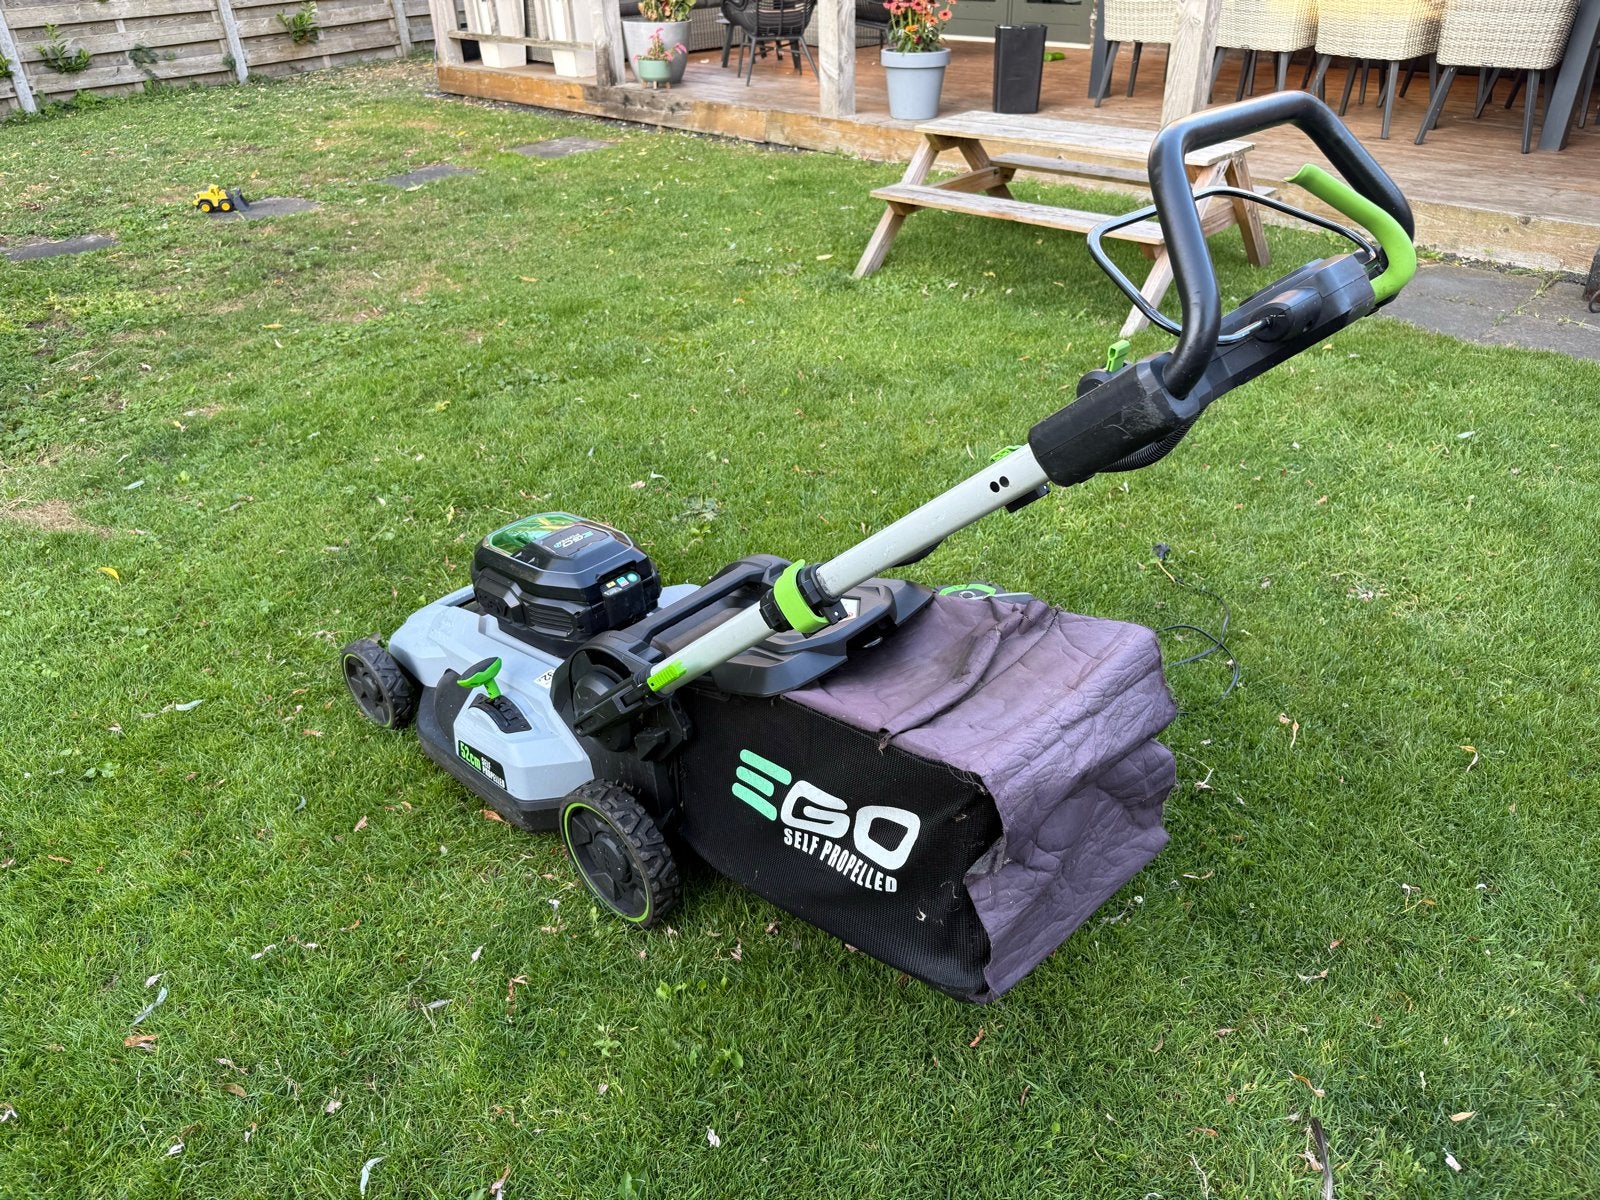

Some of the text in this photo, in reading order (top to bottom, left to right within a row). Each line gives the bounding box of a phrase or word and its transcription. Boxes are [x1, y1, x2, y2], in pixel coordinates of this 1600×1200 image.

[460, 742, 482, 771] 52cm
[731, 749, 921, 870] EGO
[783, 828, 898, 893] SELF PROPELLED
